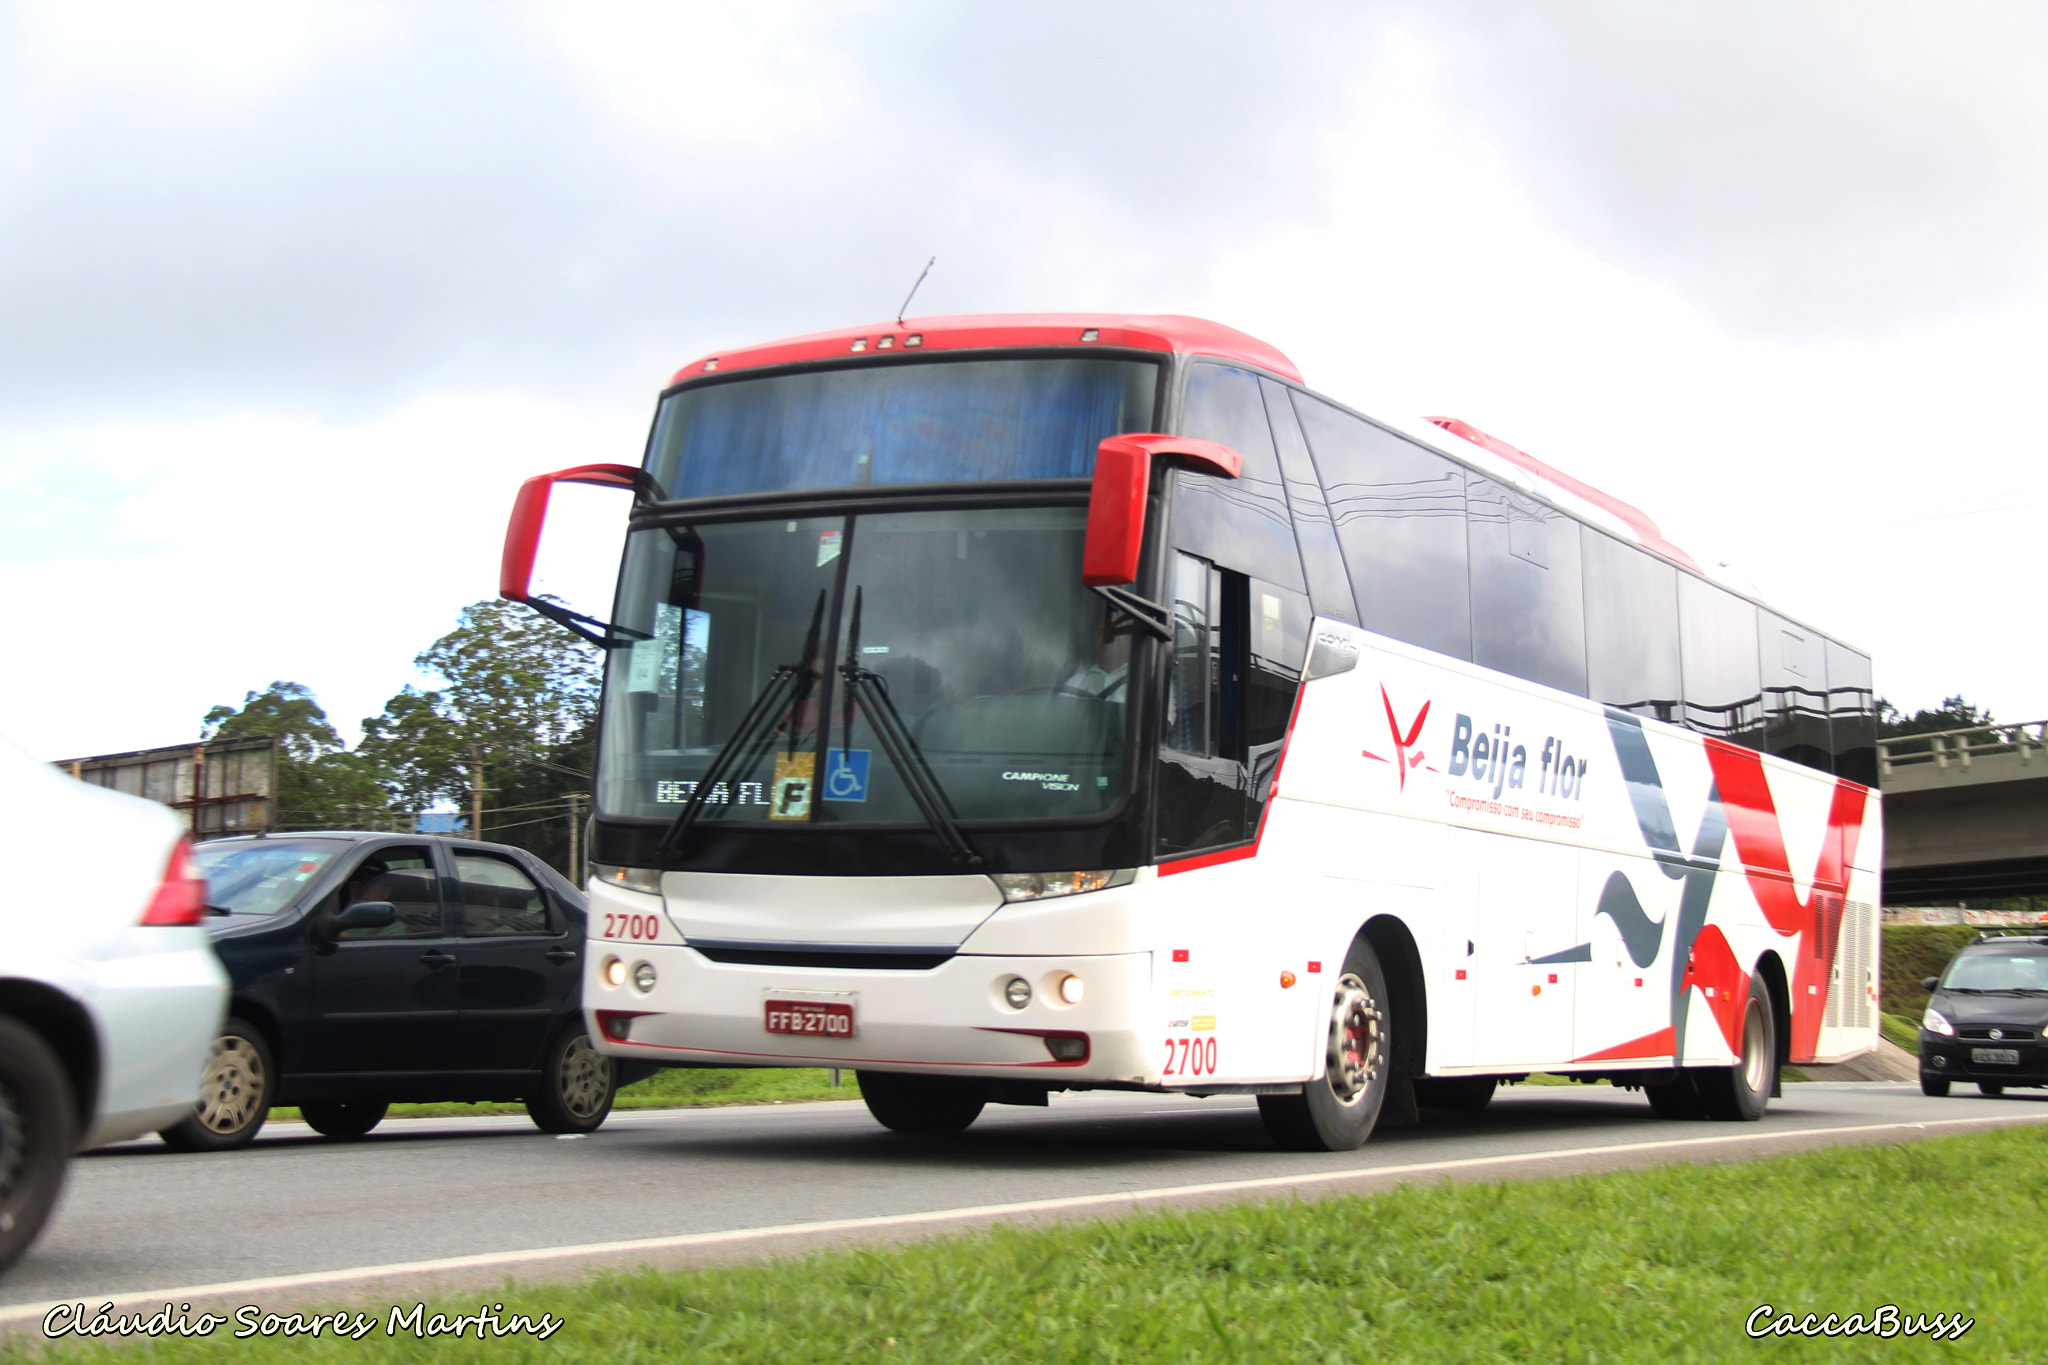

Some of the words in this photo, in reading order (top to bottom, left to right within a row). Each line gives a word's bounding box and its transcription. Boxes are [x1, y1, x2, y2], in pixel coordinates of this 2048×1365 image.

[1448, 712, 1527, 800] Beija
[1539, 735, 1588, 801] flor
[1001, 771, 1070, 783] CAMPIONE
[1041, 781, 1080, 791] VISION
[779, 782, 807, 814] F
[1503, 804, 1519, 819] com
[1521, 807, 1534, 821] seu
[603, 912, 660, 940] 2700
[1162, 1036, 1218, 1076] 2700
